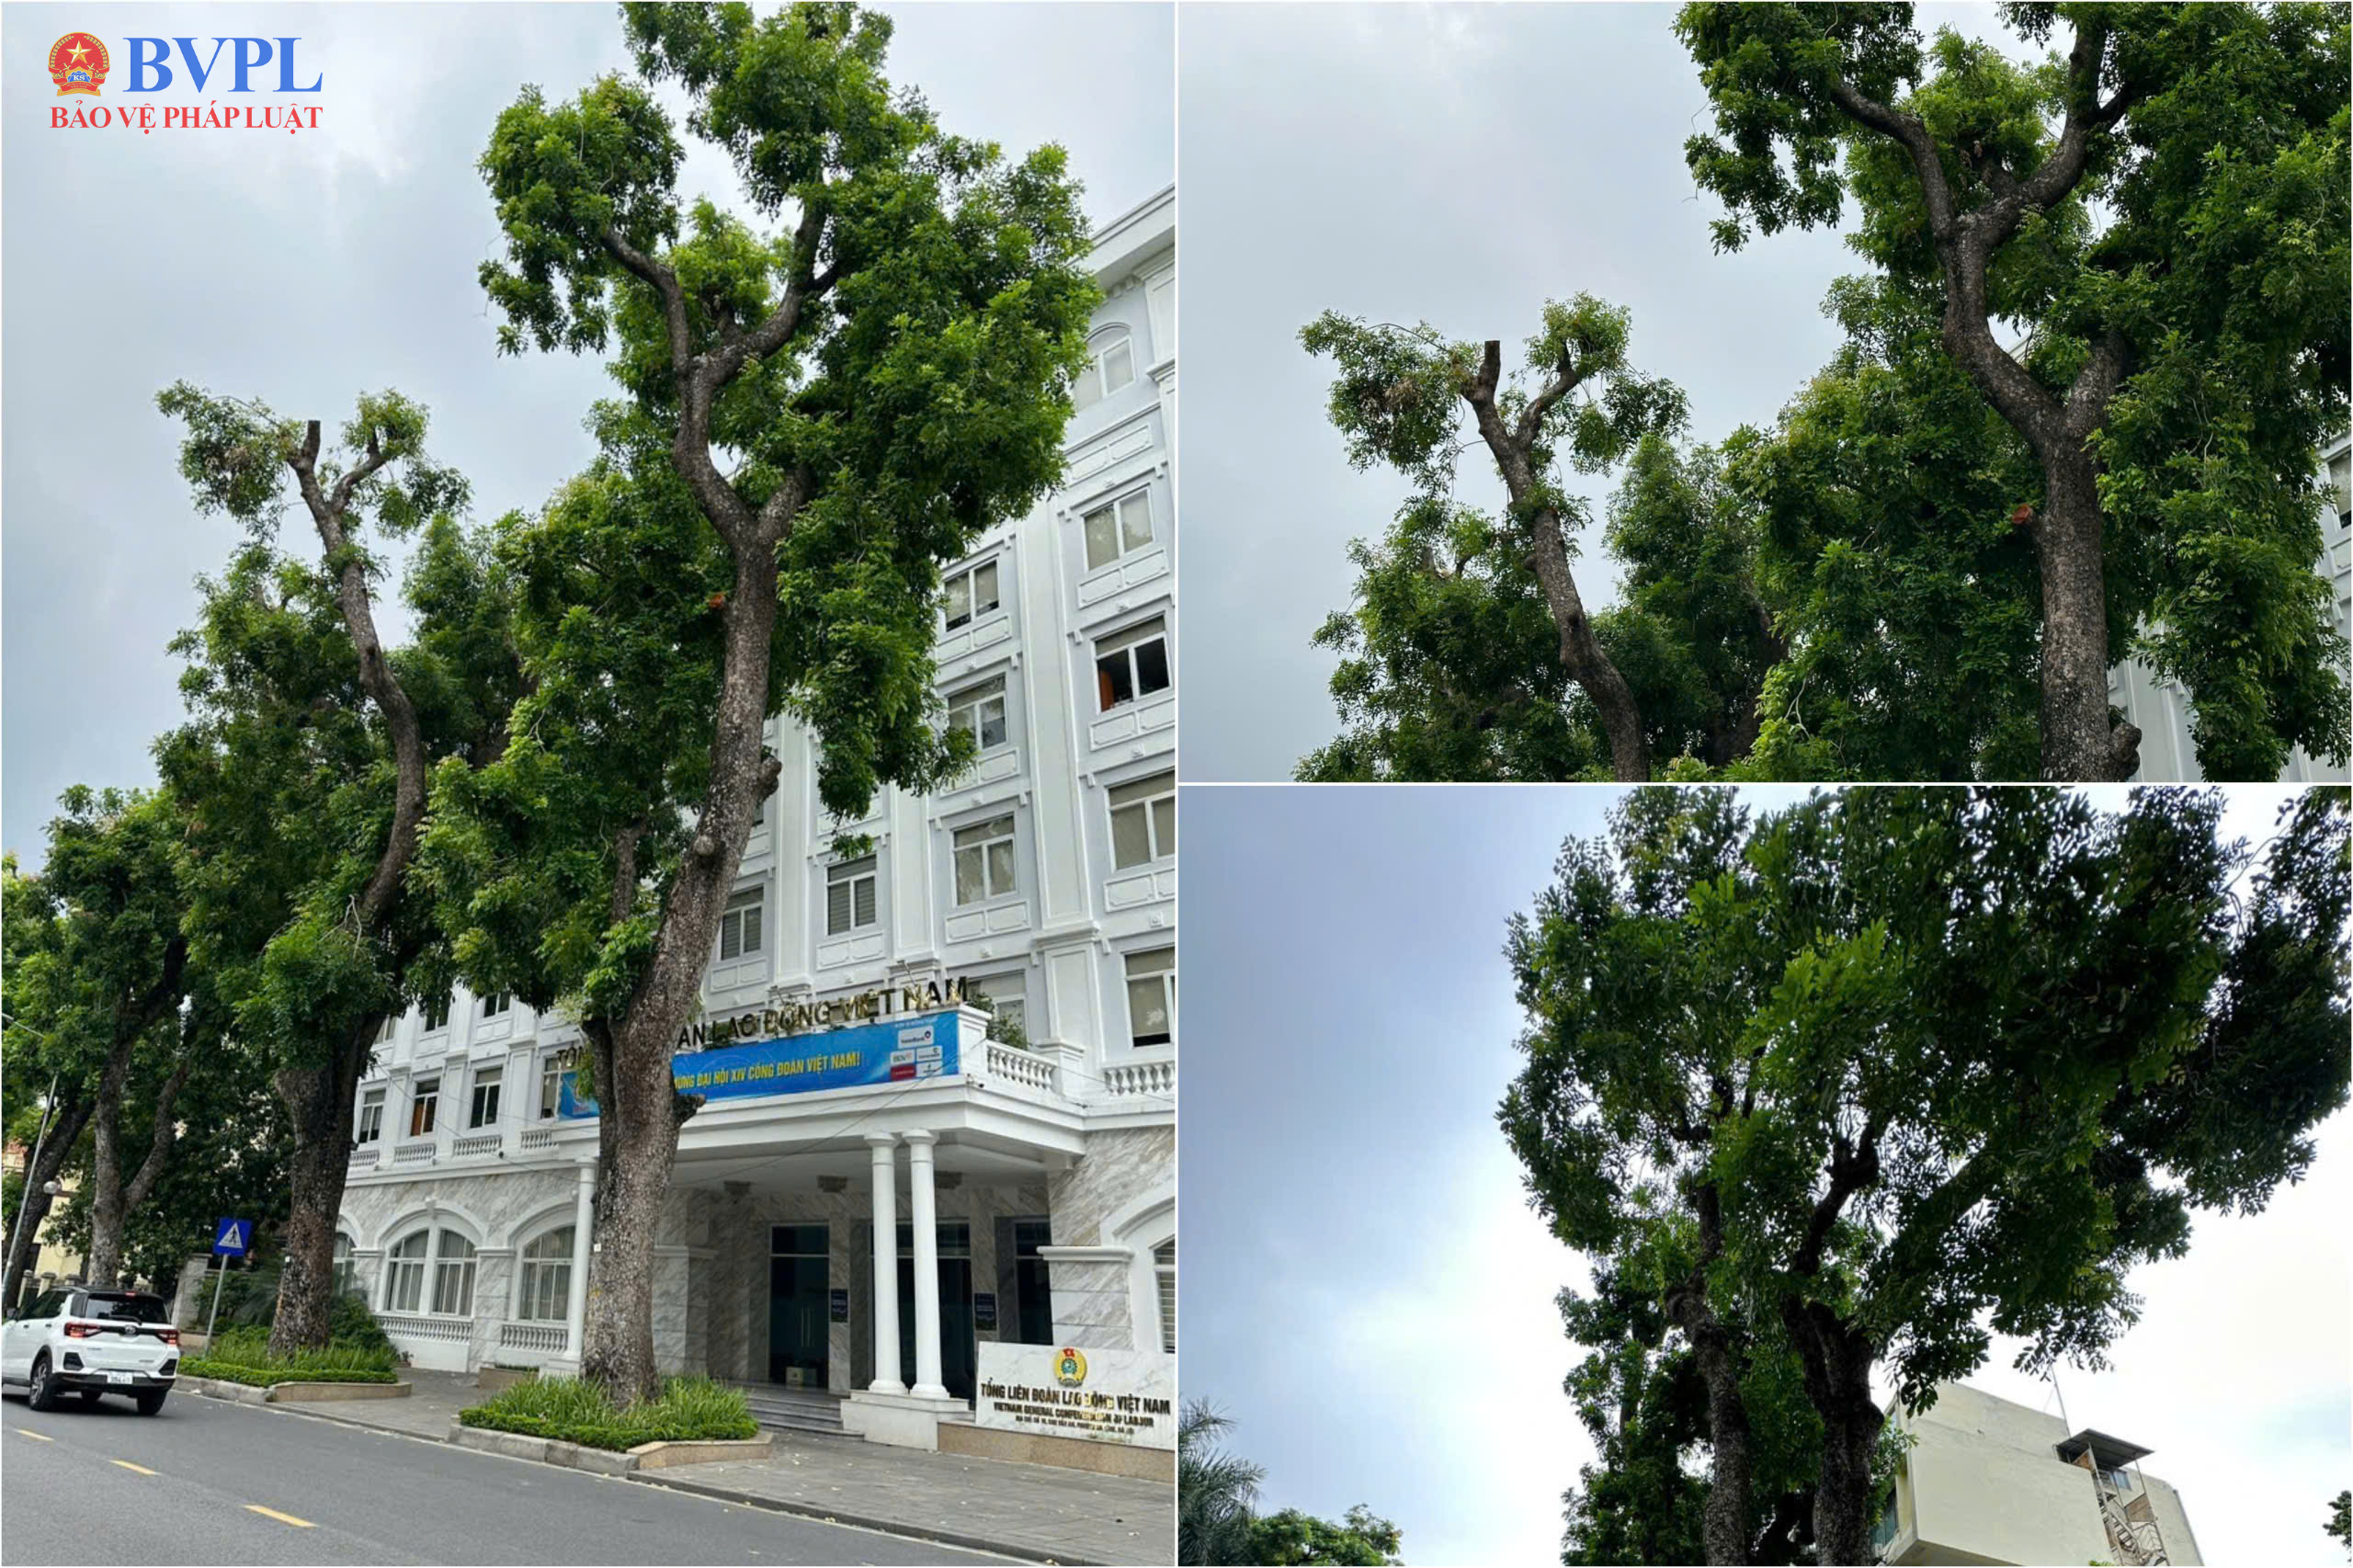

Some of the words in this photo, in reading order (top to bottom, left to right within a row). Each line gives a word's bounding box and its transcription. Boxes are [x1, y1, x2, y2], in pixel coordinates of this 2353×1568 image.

[904, 976, 968, 1012] NAM
[981, 1377, 1006, 1399] TỔNG
[1007, 1384, 1030, 1402] LIÊN
[1116, 1393, 1141, 1414] VIỆT
[1142, 1398, 1171, 1415] NAM
[994, 1402, 1023, 1414] VIETNAM
